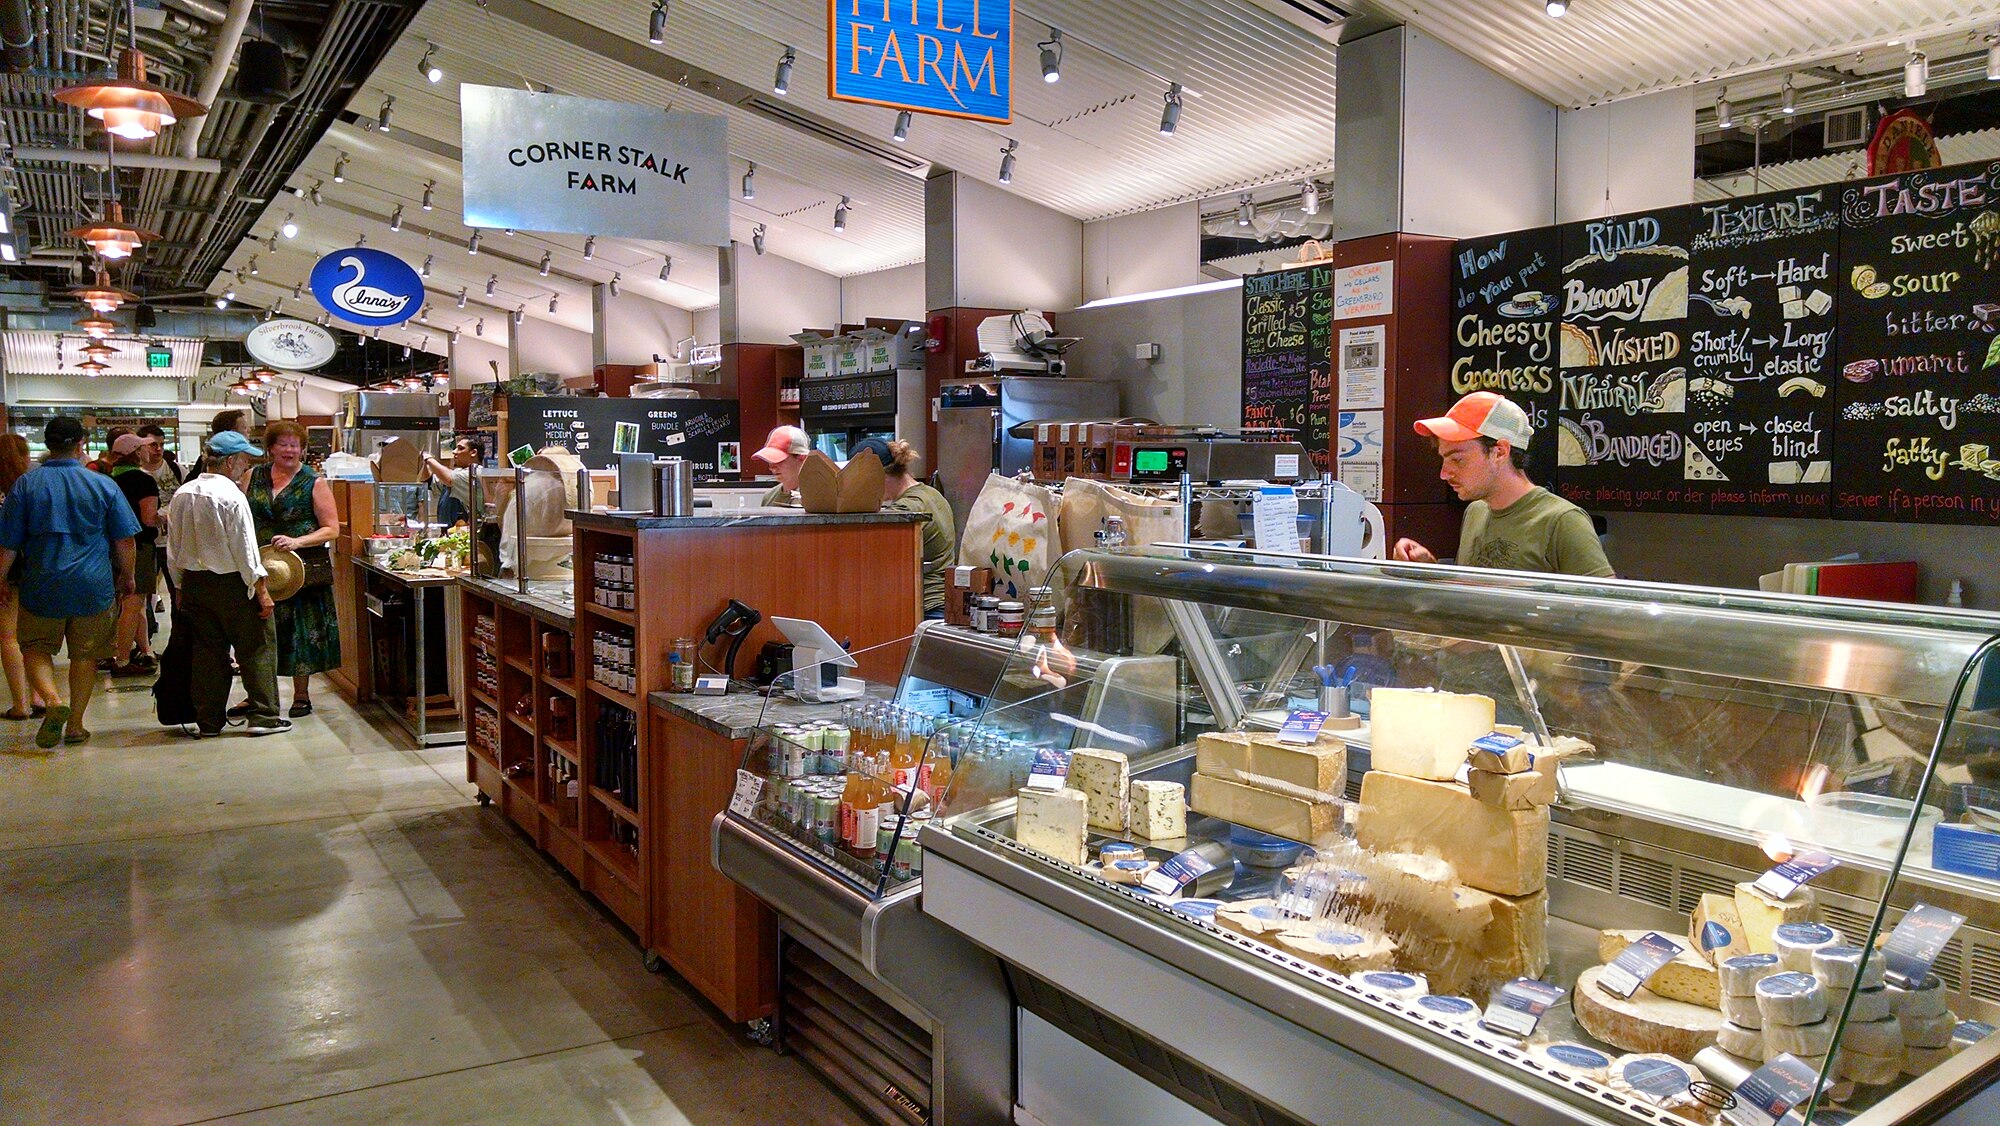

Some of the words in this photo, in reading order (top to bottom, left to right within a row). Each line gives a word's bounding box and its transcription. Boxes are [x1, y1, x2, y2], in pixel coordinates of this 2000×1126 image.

[848, 22, 1002, 109] FARM
[508, 141, 612, 167] CORNER
[617, 146, 690, 184] STALK
[567, 171, 636, 195] FARM
[1863, 172, 1987, 214] TASTE
[1703, 190, 1823, 239] TEXTURE
[1458, 240, 1507, 279] How
[1457, 287, 1475, 309] do
[1518, 252, 1546, 288] put
[1700, 265, 1748, 298] Soft
[1776, 252, 1831, 286] Hard
[349, 289, 401, 309] Inna's
[1247, 296, 1285, 316] Classic
[1289, 297, 1308, 318] $5
[1344, 302, 1382, 316] VERMONT
[258, 322, 302, 336] Silverbrook
[304, 326, 325, 339] Farm
[1246, 310, 1286, 335] Grilled
[1886, 311, 1966, 336] bitter
[1267, 331, 1305, 348] Cheese
[1457, 314, 1552, 362] Cheesy
[1587, 326, 1681, 366] WASHED
[151, 353, 170, 367] EXIT
[1452, 350, 1553, 395] Goodness
[1764, 353, 1821, 377] elastic
[1881, 350, 1970, 377] umami
[871, 380, 892, 398] YEAR
[1560, 371, 1664, 416] NATURAL
[96, 417, 138, 425] Crescent
[140, 417, 165, 426] Ridge
[543, 410, 578, 418] LETTUCE
[1245, 404, 1276, 419] FANCY
[1290, 404, 1305, 424] $6
[1885, 389, 1959, 431] salty
[545, 431, 572, 439] MEDIUM
[651, 422, 679, 430] BUNDLE
[1581, 412, 1682, 467] BANDAGED
[1693, 419, 1732, 443] open
[1764, 412, 1813, 435] closed
[1706, 436, 1743, 461] eyes
[1772, 429, 1822, 458] blind
[1882, 437, 1951, 481] fatty
[1596, 485, 1632, 507] placing
[1636, 489, 1664, 507] your
[1711, 488, 1746, 510] please
[1750, 488, 1790, 506] inform
[1888, 488, 1902, 513] if
[1902, 495, 1911, 508] a
[1914, 494, 1965, 518] person
[1971, 494, 1985, 511] in
